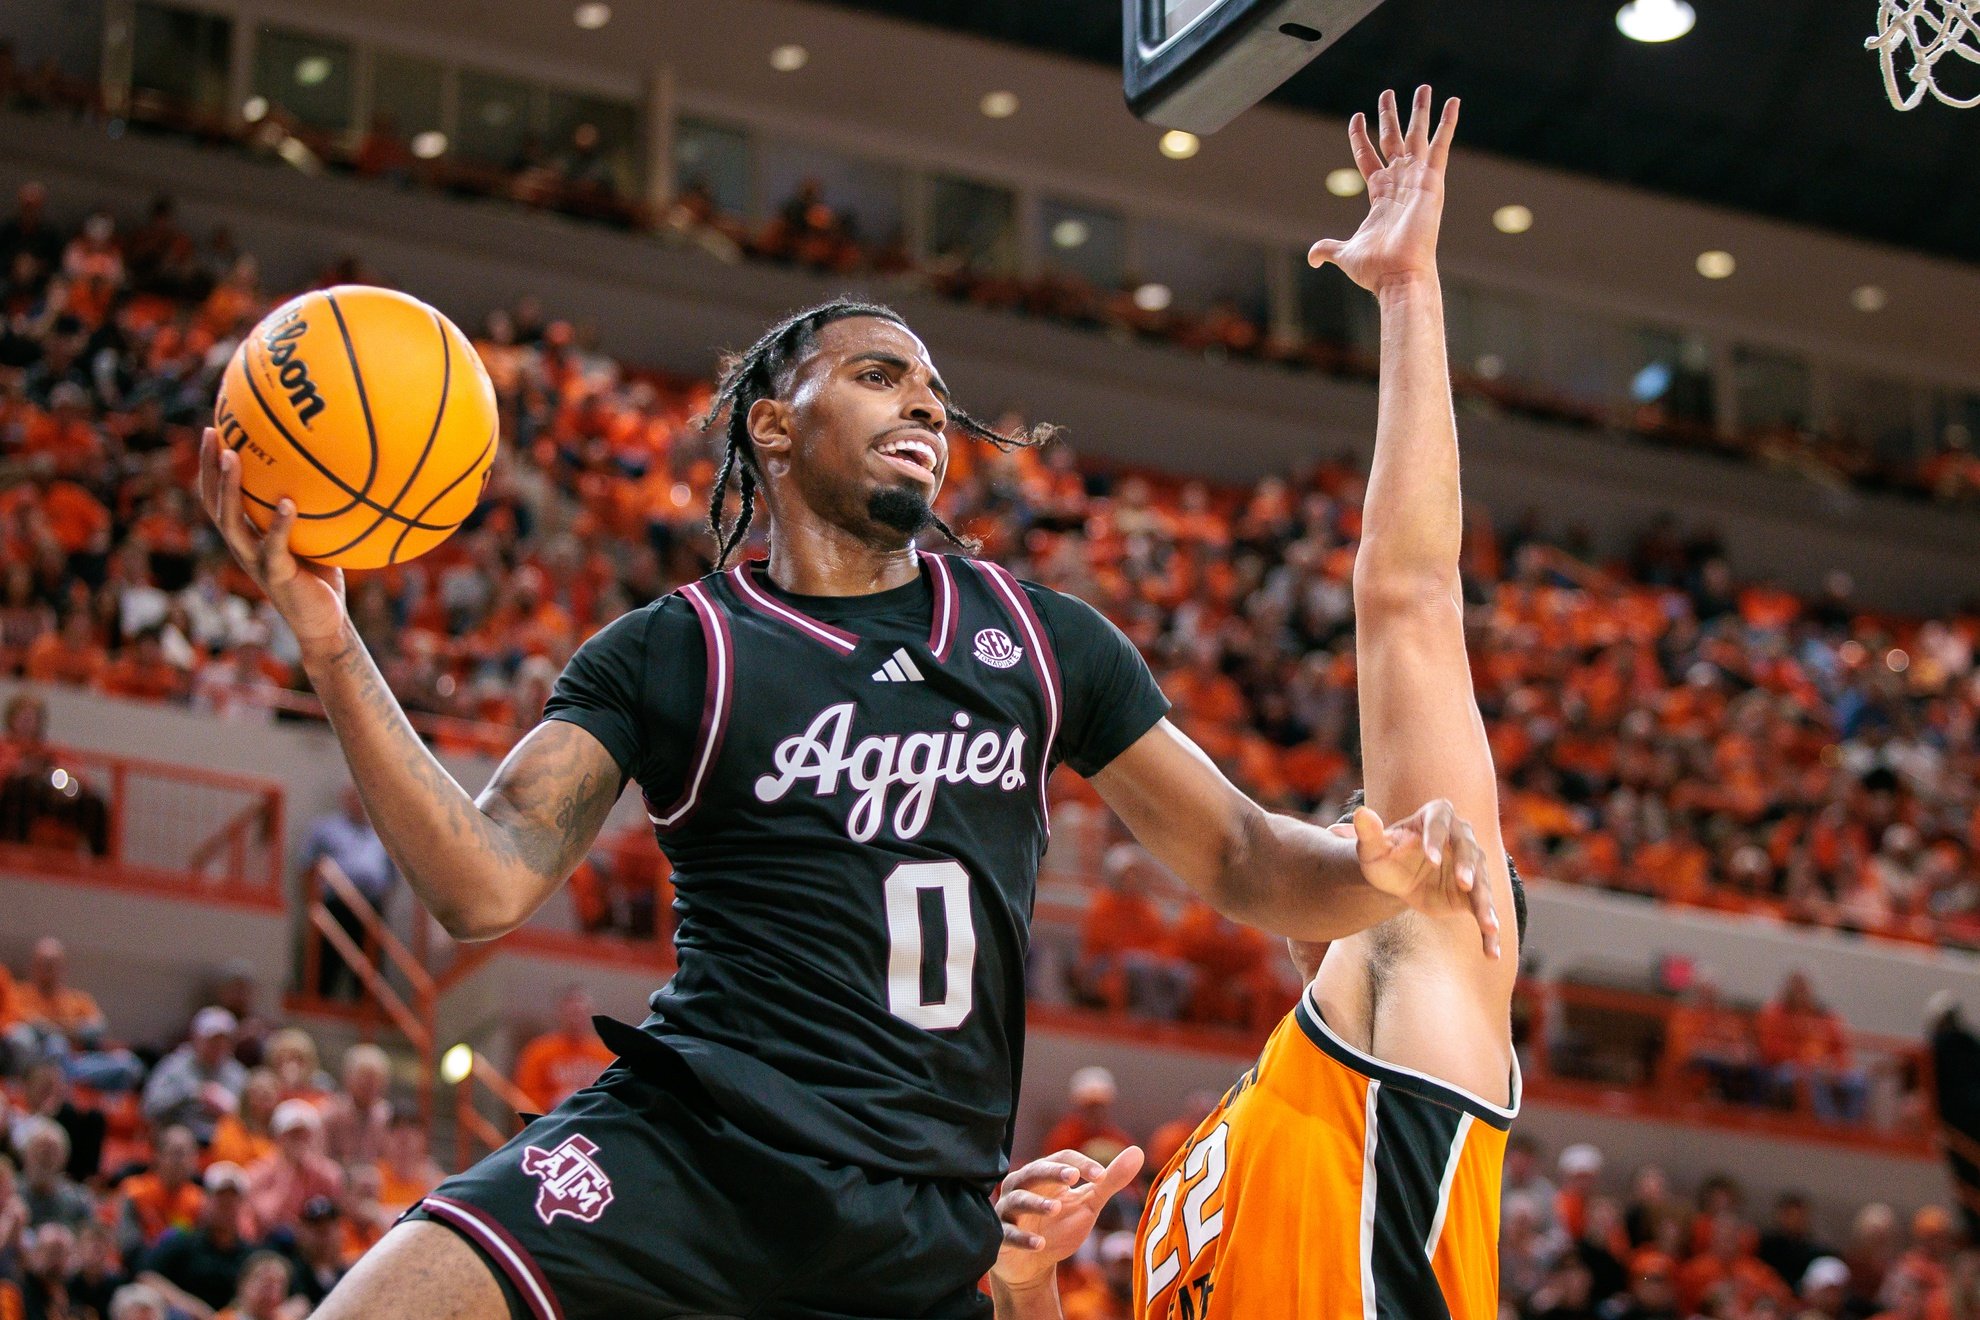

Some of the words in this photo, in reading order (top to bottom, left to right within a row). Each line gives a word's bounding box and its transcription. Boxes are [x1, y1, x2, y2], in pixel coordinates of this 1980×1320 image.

[218, 398, 249, 453] VO
[249, 443, 277, 466] NXT
[263, 304, 325, 430] ilson
[977, 630, 1010, 658] SEC
[755, 701, 1029, 843] Aggies
[882, 859, 977, 1030] 0
[1144, 1121, 1230, 1308] 22
